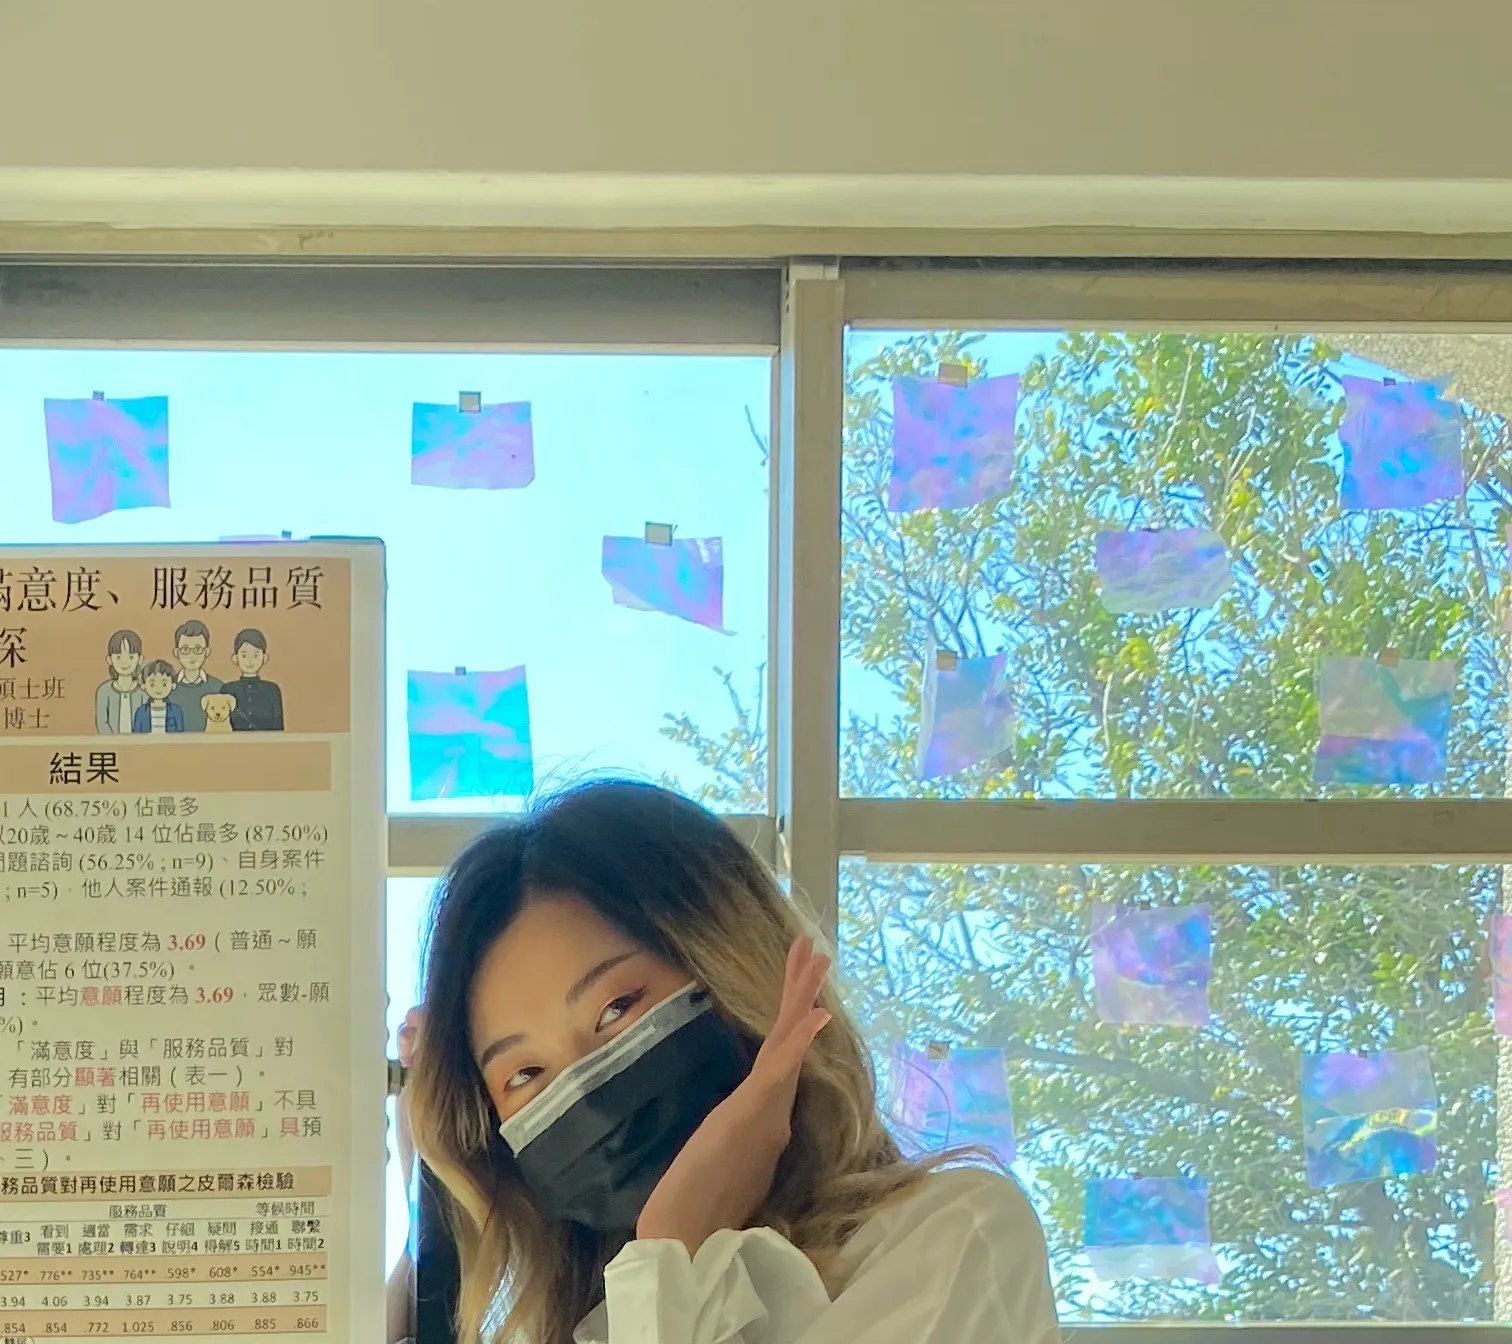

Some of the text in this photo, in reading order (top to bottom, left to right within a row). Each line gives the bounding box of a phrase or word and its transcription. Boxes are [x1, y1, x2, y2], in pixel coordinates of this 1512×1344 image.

[49, 751, 120, 785] 結果
[134, 796, 199, 818] 佔最多
[126, 826, 144, 843] 14
[151, 822, 239, 844] 位佔最多
[245, 824, 328, 845] (87.50%)
[64, 963, 75, 979] 6
